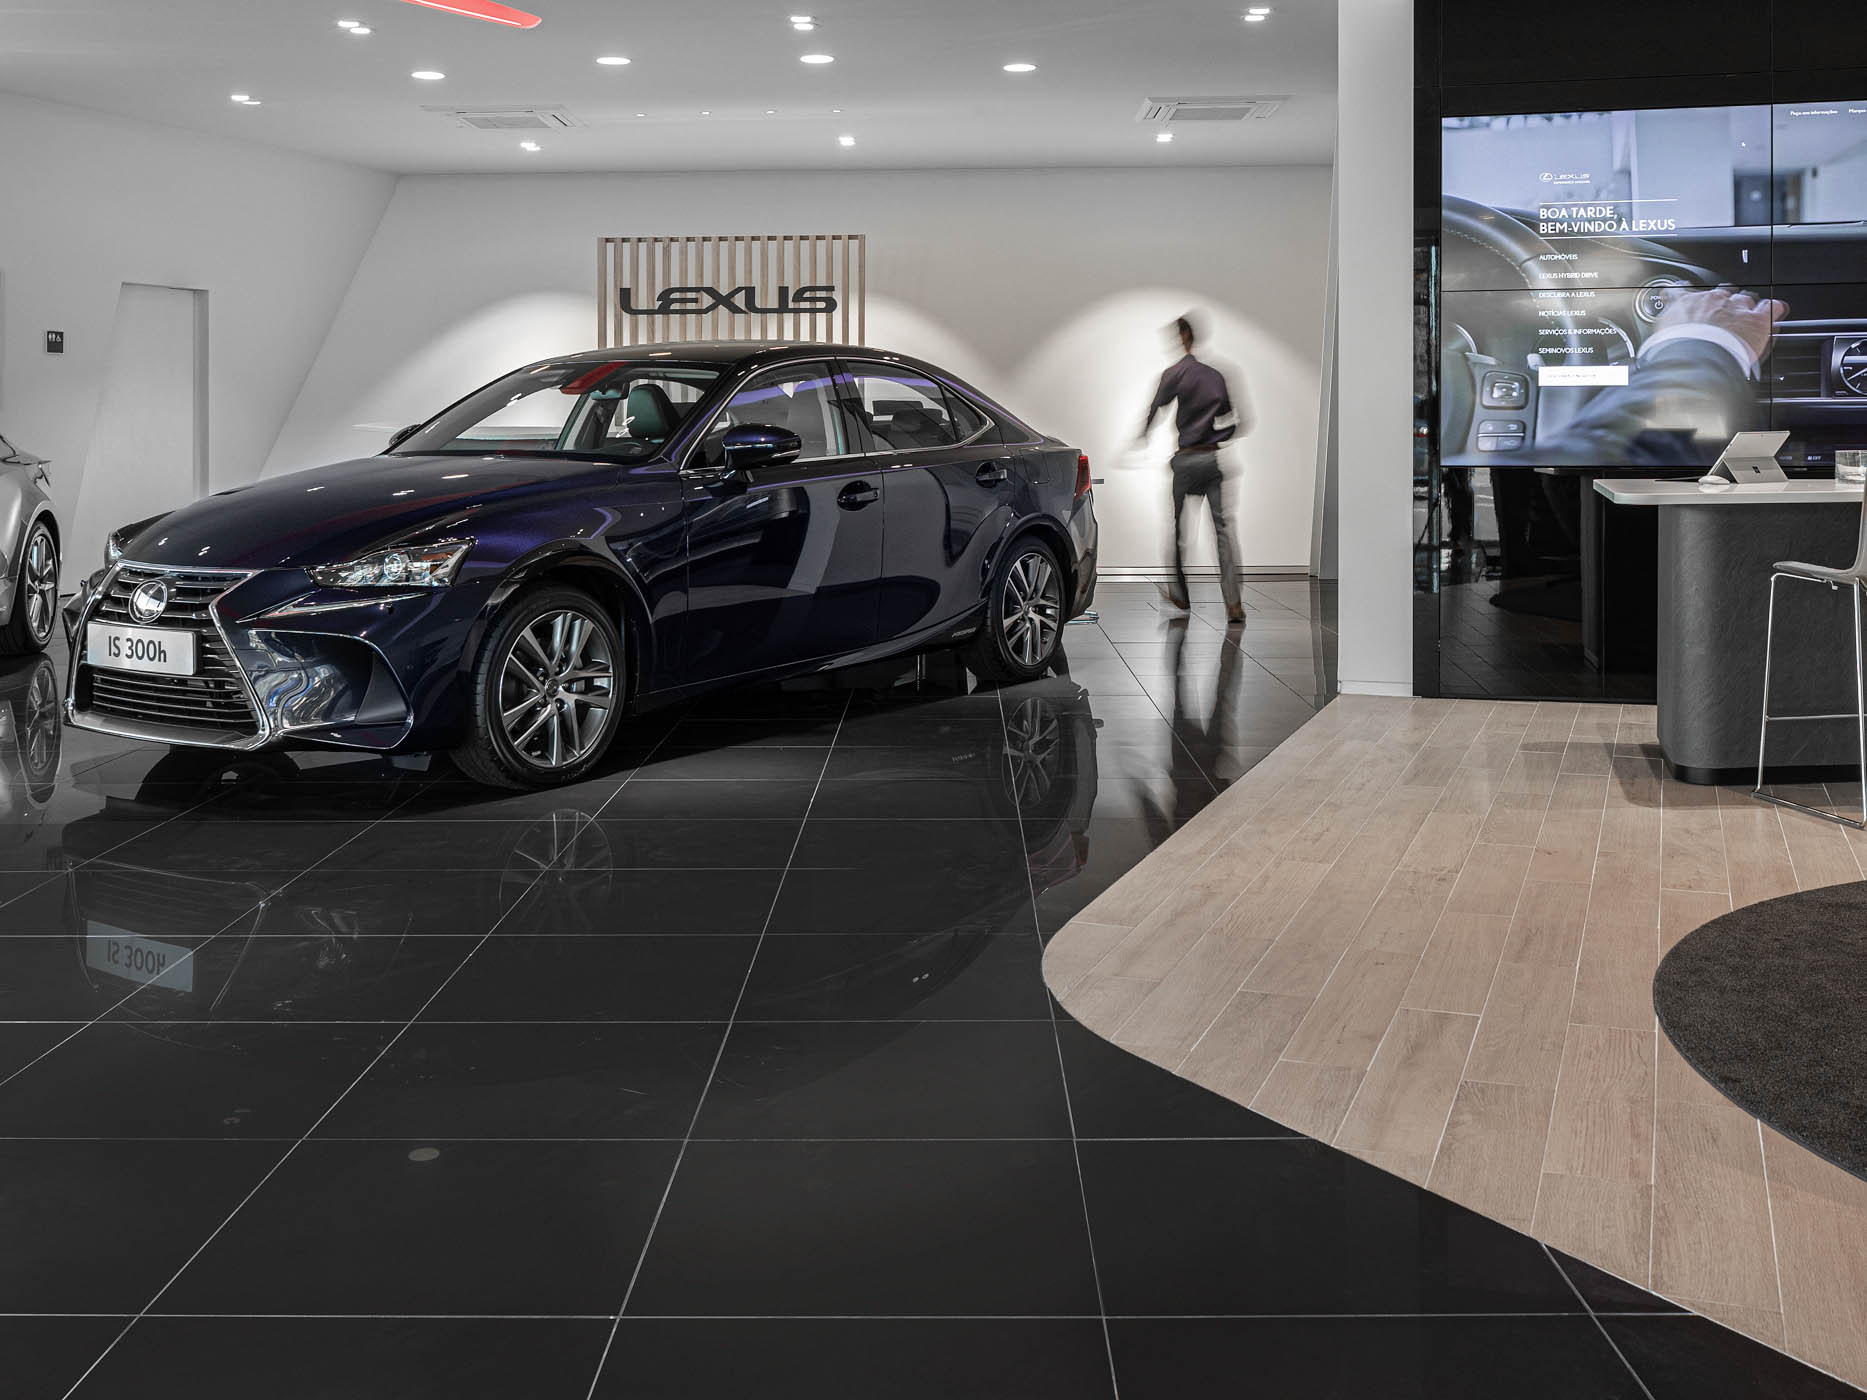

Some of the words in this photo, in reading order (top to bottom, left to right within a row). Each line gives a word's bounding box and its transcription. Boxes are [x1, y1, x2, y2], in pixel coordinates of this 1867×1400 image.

[1540, 207, 1568, 219] BOA
[1571, 206, 1617, 219] TARDE,
[1540, 221, 1617, 233] BEM-VINDO
[1620, 218, 1630, 231] À
[1632, 219, 1676, 231] LEXUS
[620, 286, 837, 315] LEXUS
[1539, 328, 1567, 336] SERVIÇOS
[108, 635, 121, 658] IS
[125, 637, 167, 663] 300h
